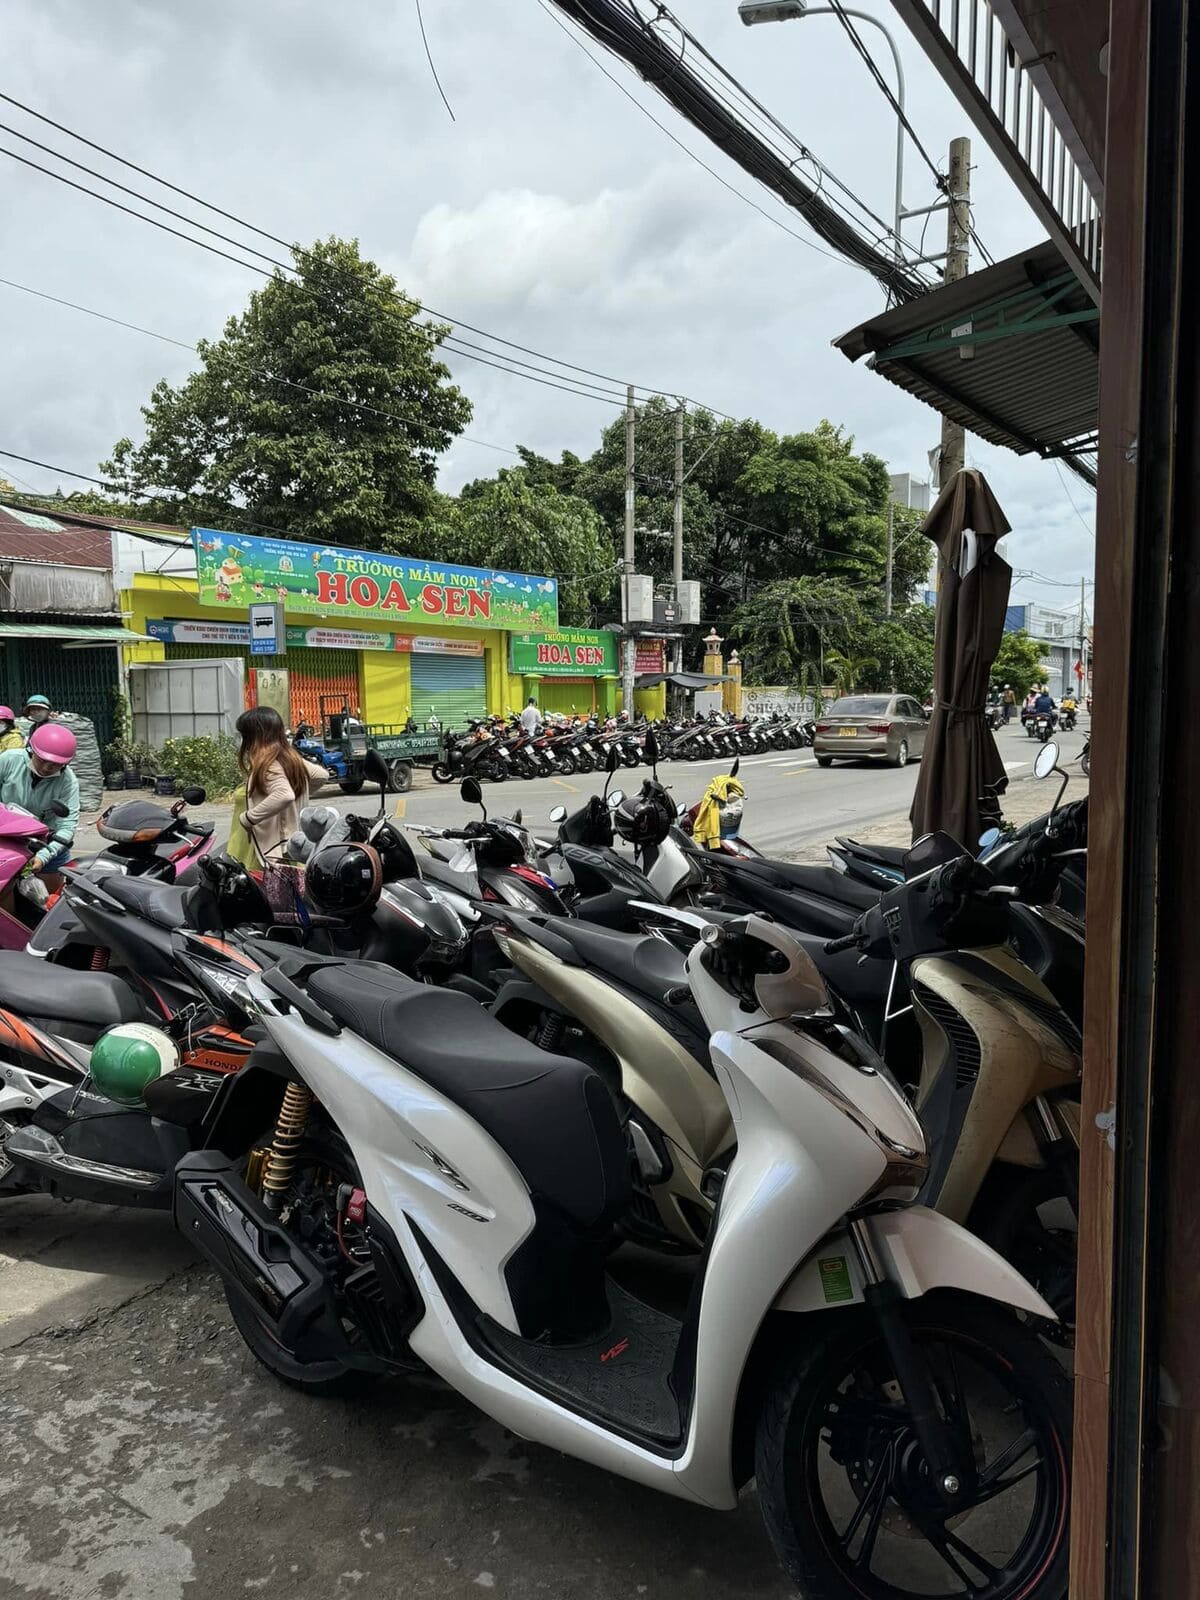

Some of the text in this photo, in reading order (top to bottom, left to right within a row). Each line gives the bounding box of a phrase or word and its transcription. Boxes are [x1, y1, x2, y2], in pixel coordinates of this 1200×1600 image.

[333, 557, 404, 579] TRƯỜNG
[409, 563, 445, 584] MẦM
[450, 574, 478, 587] NON
[316, 570, 411, 612] HOA
[421, 583, 492, 619] SEN
[537, 643, 604, 666] HOA SEN
